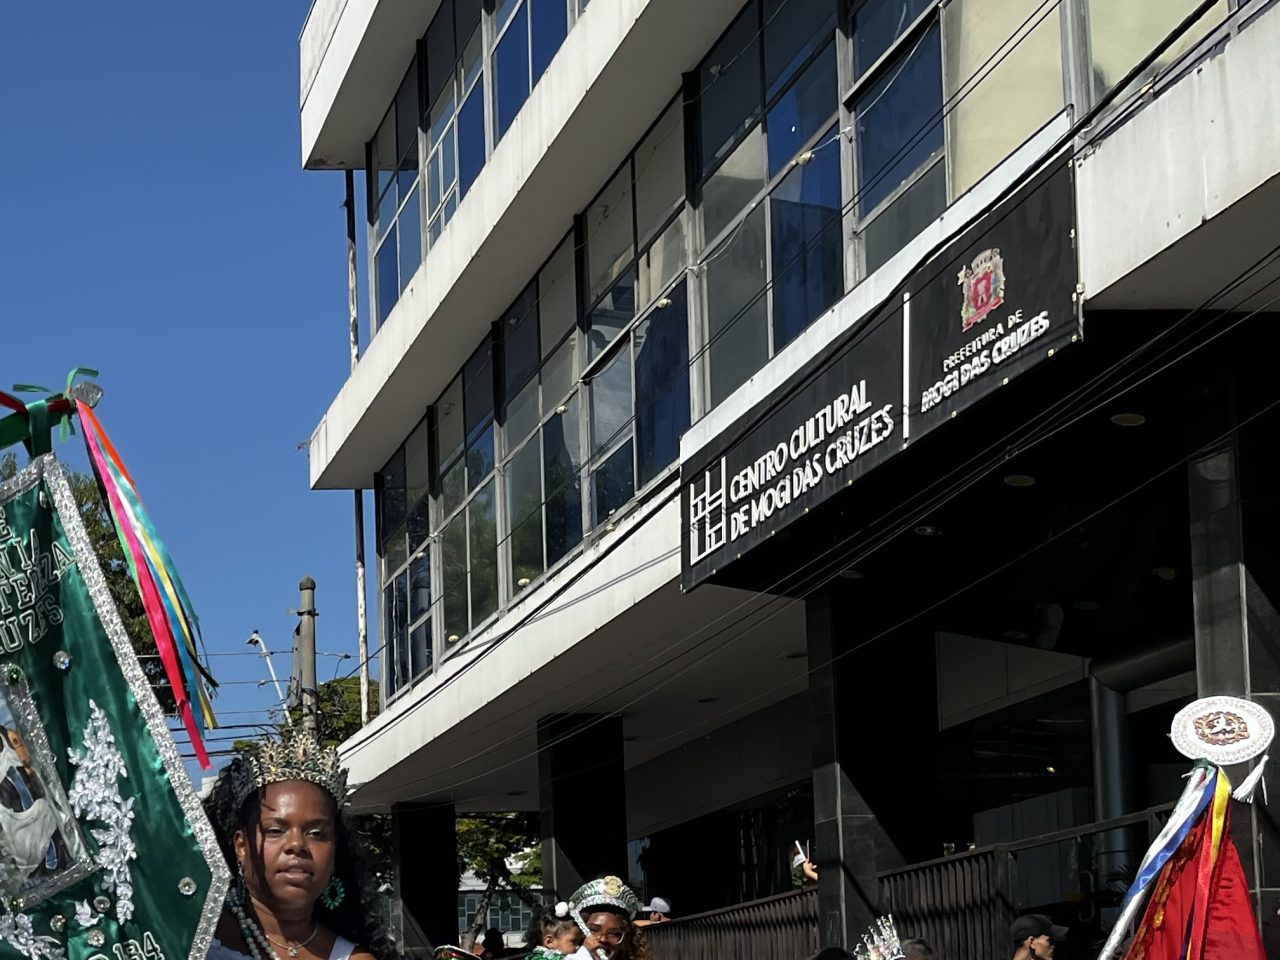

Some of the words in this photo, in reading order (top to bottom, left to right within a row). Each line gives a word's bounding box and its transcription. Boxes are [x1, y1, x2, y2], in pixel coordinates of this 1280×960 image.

[921, 370, 959, 412] MOGI
[960, 350, 991, 386] DAS
[992, 310, 1050, 364] CRUZES
[943, 323, 1004, 372] PREFEITURA
[1008, 310, 1023, 328] DE
[730, 442, 788, 503] CENTRO
[789, 380, 872, 460] CULTURAL
[731, 505, 750, 541] DE
[752, 475, 790, 527] MOGI
[793, 453, 823, 499] DAS
[825, 404, 894, 474] CRUZES
